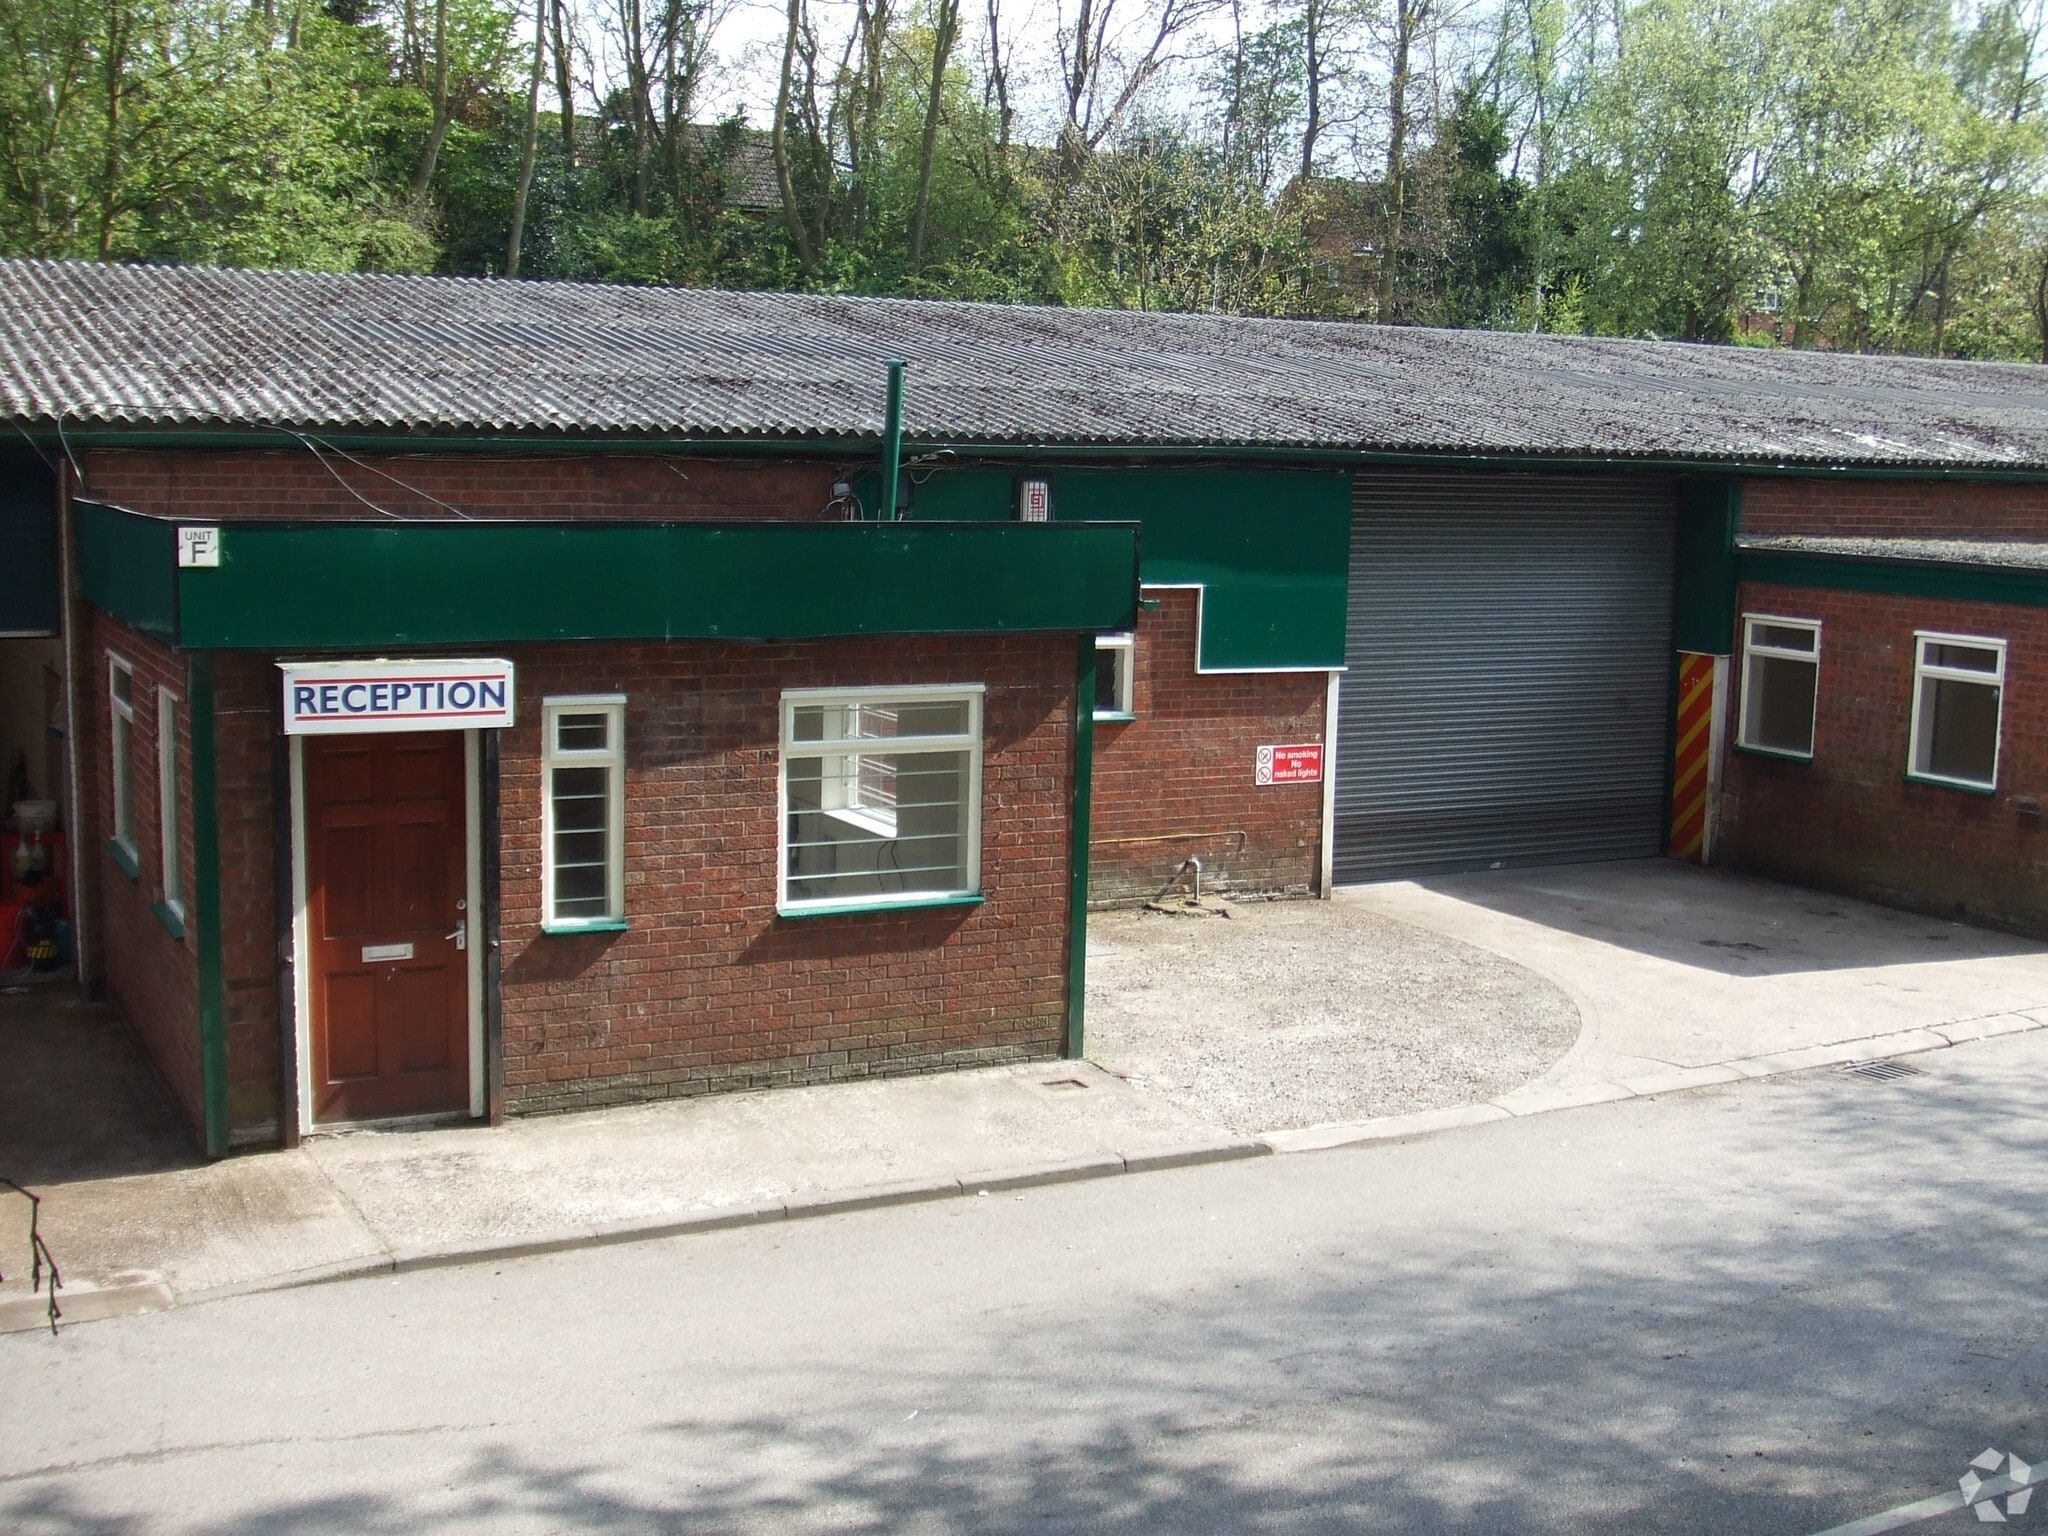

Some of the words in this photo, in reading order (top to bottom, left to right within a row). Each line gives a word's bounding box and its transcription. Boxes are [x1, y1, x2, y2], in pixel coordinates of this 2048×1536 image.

[185, 531, 212, 541] UNIT
[192, 541, 207, 564] F
[294, 681, 505, 714] RECEPTION
[1275, 751, 1286, 760] No
[1287, 750, 1318, 759] smoking
[1290, 760, 1302, 768] No
[1274, 770, 1296, 778] naked
[1297, 768, 1318, 778] lights
